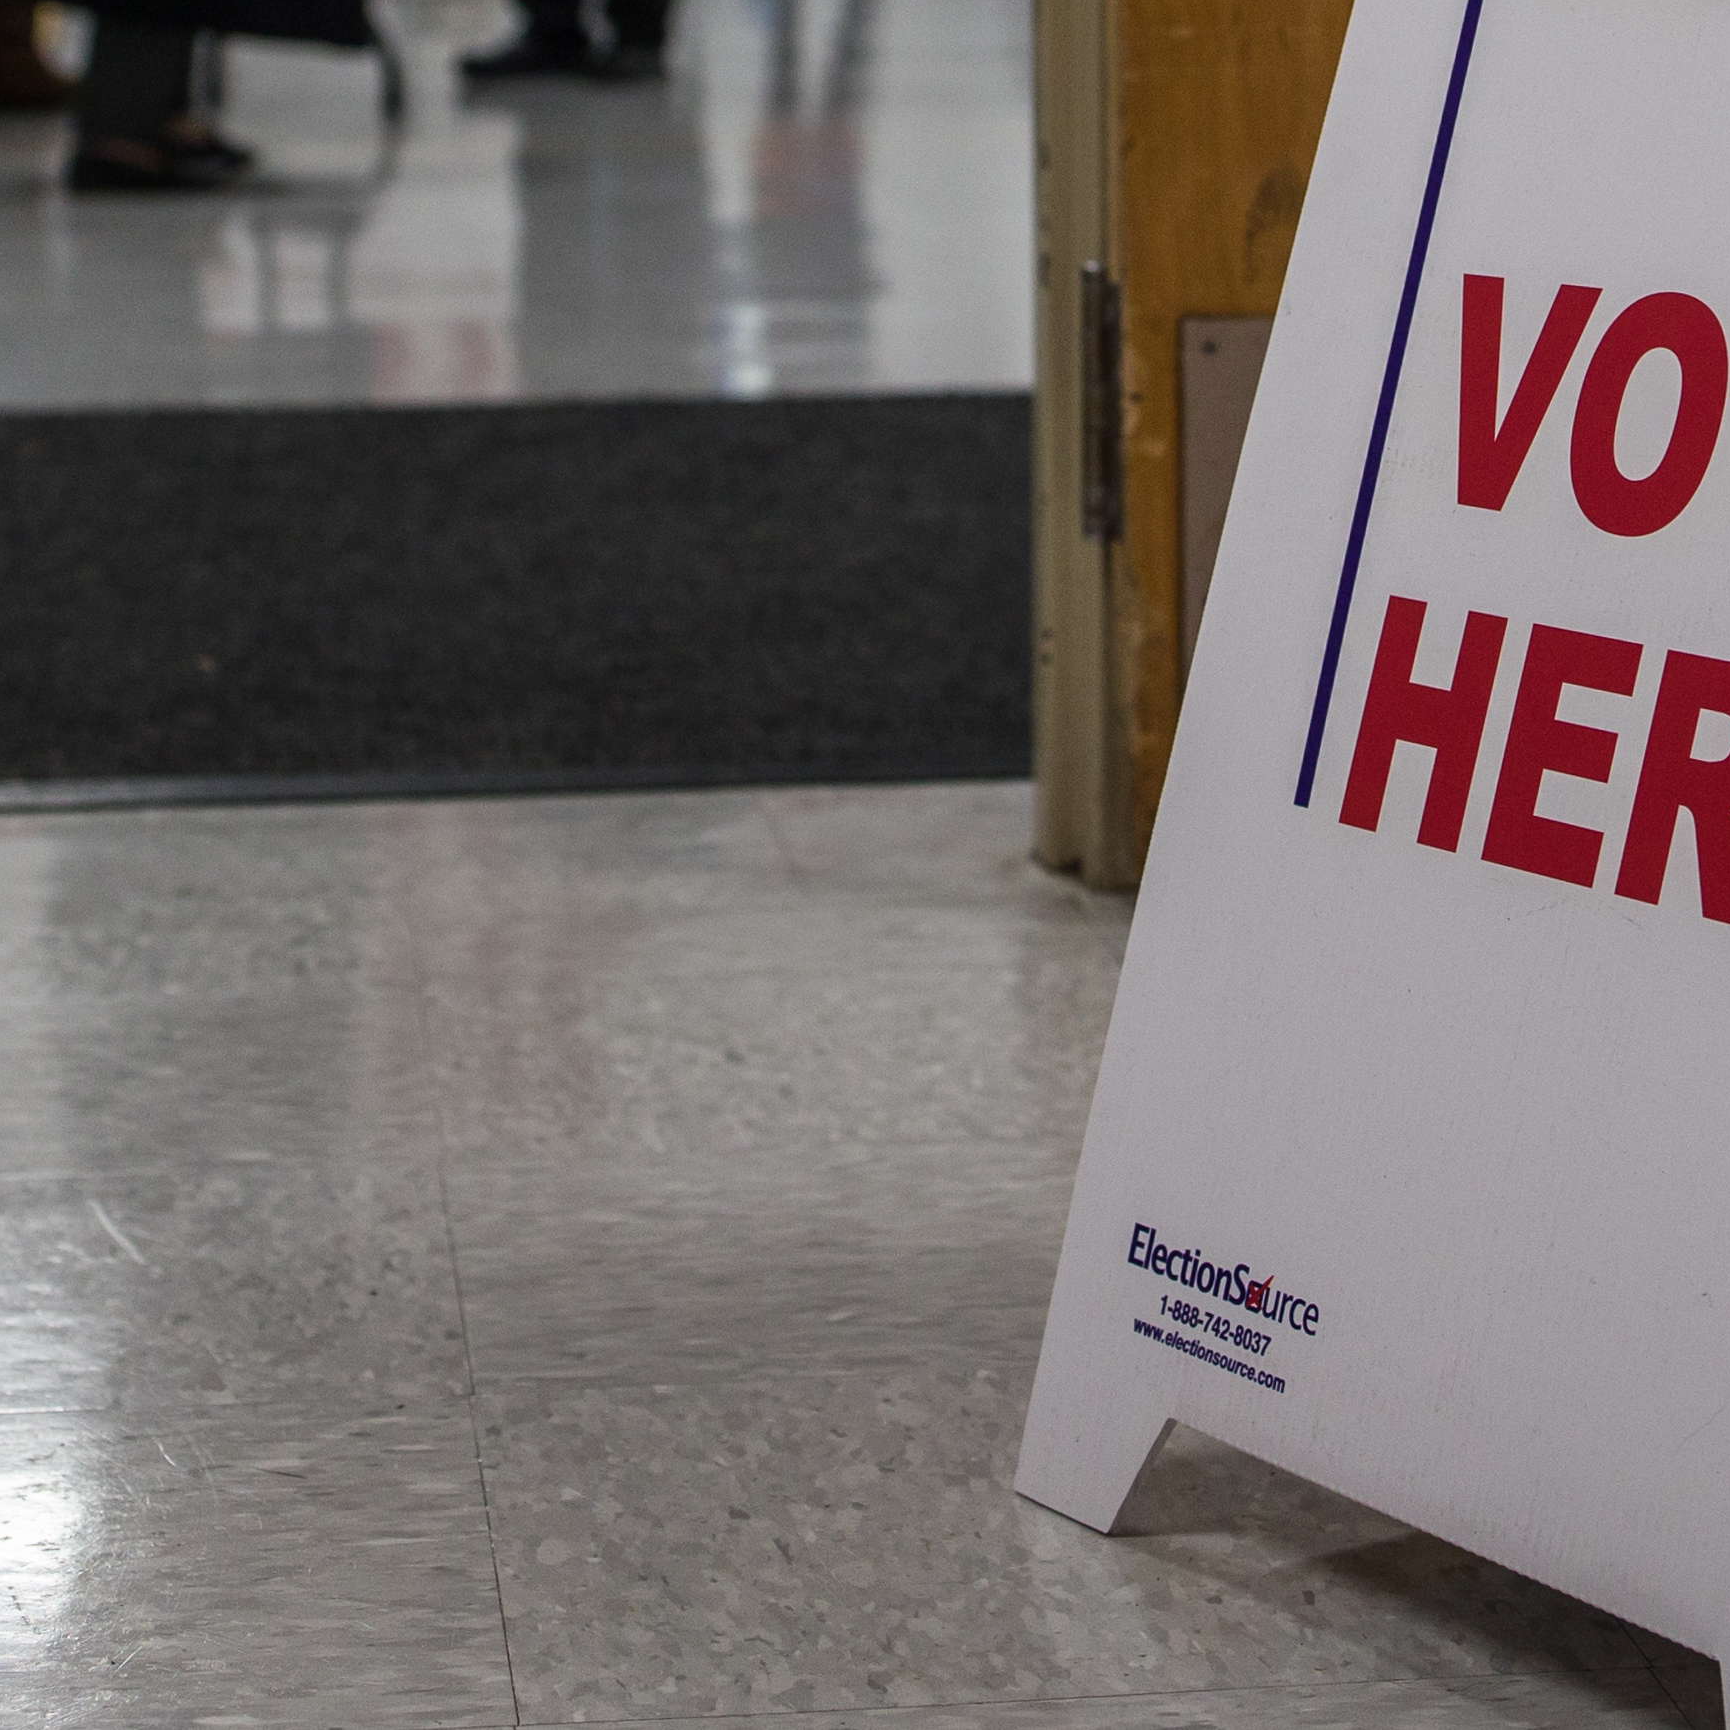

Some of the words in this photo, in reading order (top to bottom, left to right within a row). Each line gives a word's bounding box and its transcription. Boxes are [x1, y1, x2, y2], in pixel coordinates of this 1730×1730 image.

[1127, 1222, 1320, 1337] ElectionSource
[1133, 1318, 1286, 1394] www.electionsource.com
[1160, 1294, 1272, 1357] 1-888-742-8037
